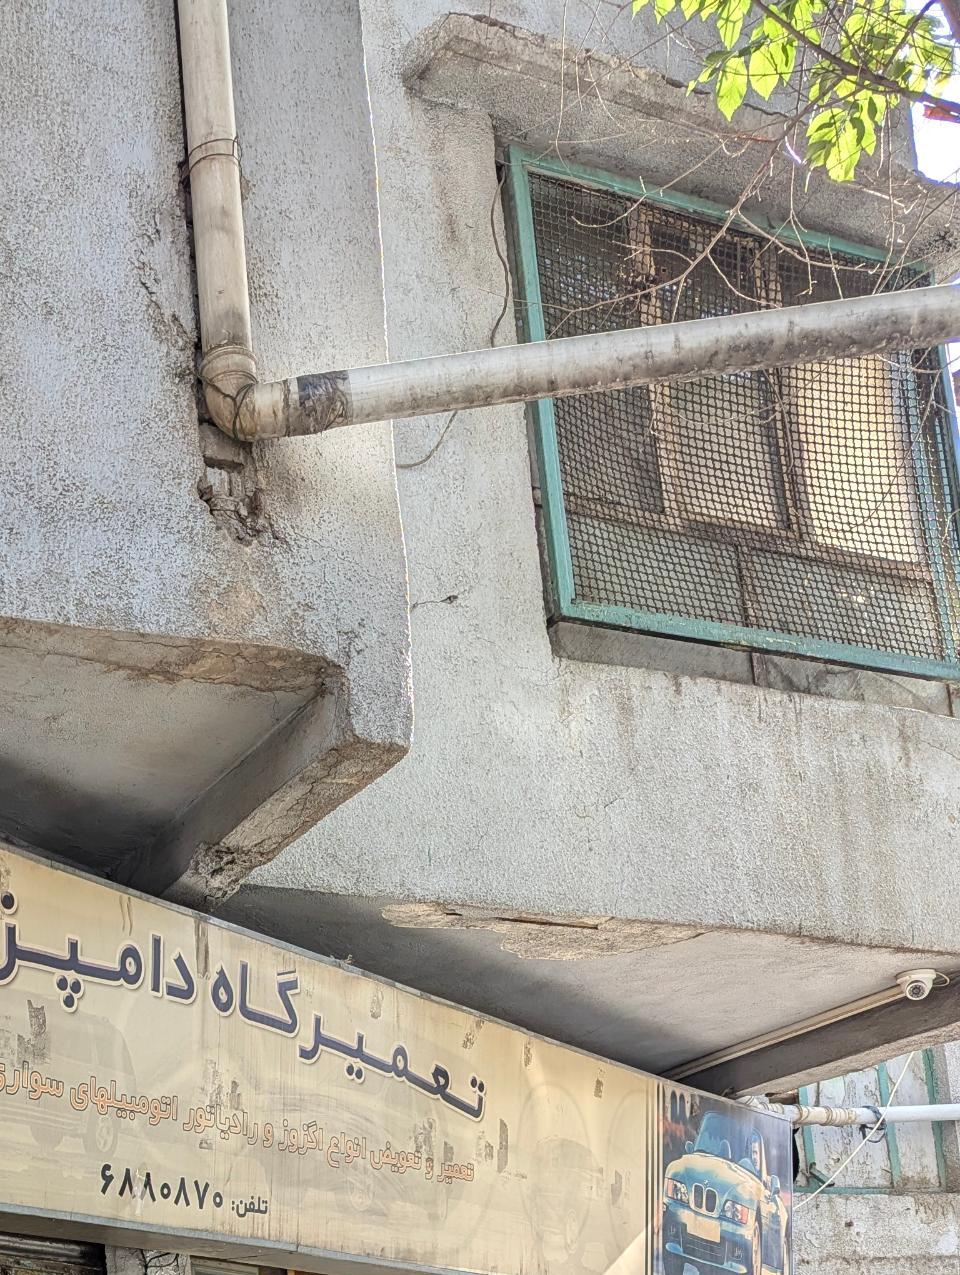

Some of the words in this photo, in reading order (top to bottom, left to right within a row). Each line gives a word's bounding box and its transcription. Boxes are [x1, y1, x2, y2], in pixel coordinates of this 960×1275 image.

[211, 960, 485, 1120] تعمیرگاه
[69, 1076, 178, 1125] اتومبیلهای
[183, 1101, 259, 1145] رادیاتور
[263, 1125, 275, 1148] و
[278, 1118, 324, 1156] اگزوز
[327, 1131, 367, 1168] انواع
[370, 1147, 422, 1174] تعویض
[426, 1158, 434, 1180] و
[437, 1161, 475, 1183] تعمیر
[231, 1196, 269, 1218] تلفن:
